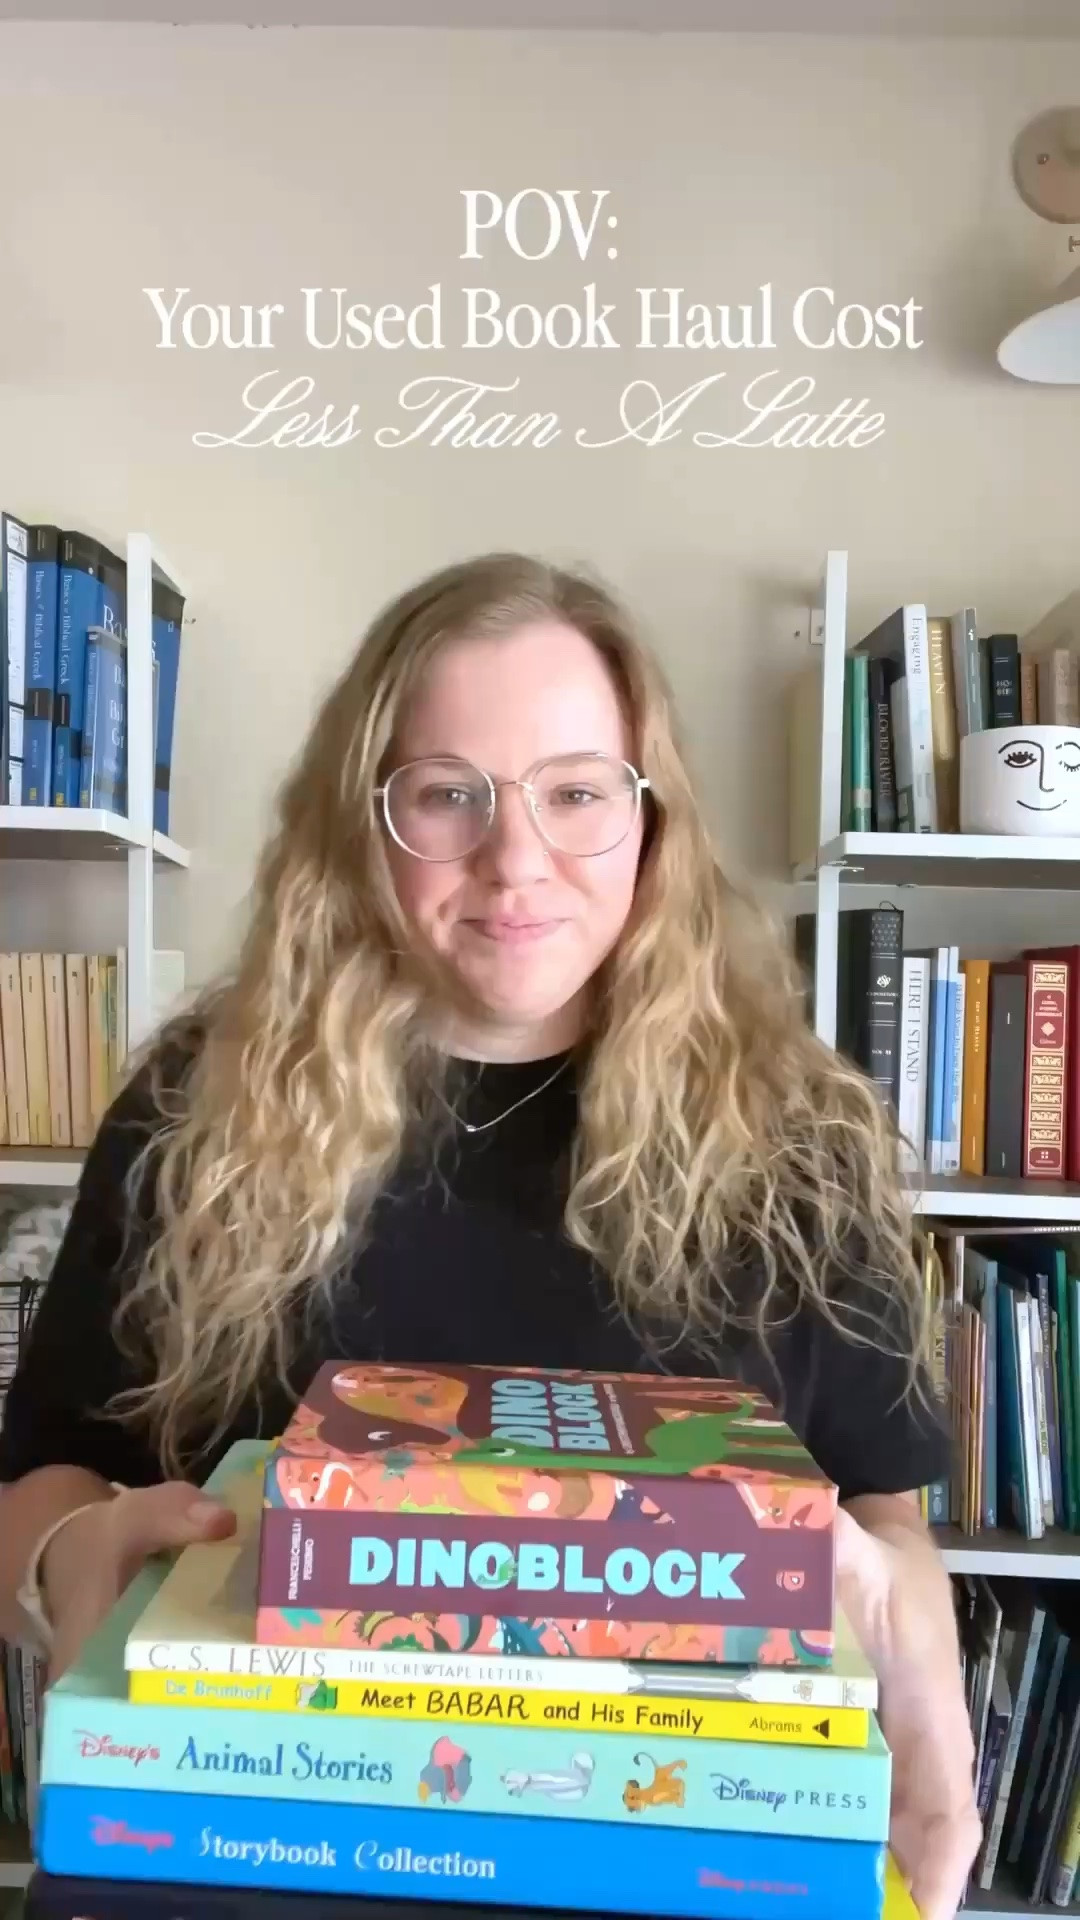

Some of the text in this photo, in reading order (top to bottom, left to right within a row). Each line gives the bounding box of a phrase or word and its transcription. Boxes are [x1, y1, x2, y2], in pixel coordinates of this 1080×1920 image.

[911, 617, 923, 675] Engaging
[907, 969, 923, 1009] HERE
[906, 1028, 921, 1082] STAND
[490, 1378, 555, 1449] DINO
[549, 1380, 612, 1451] BLOCK
[348, 1535, 747, 1601] DINOBLOCK
[148, 1643, 326, 1677] C. S. LEWIS
[349, 1659, 543, 1682] THE SCREWTAPE LETTERS
[165, 1679, 273, 1701] De Brunhoff
[360, 1688, 704, 1735] Meet BABAR and His Family
[748, 1716, 803, 1734] Abrams
[175, 1735, 284, 1777] Animal
[291, 1741, 394, 1785] Stories
[709, 1773, 868, 1813] Disney PRESS
[198, 1825, 338, 1868] Storybook
[353, 1839, 497, 1879] Collection
